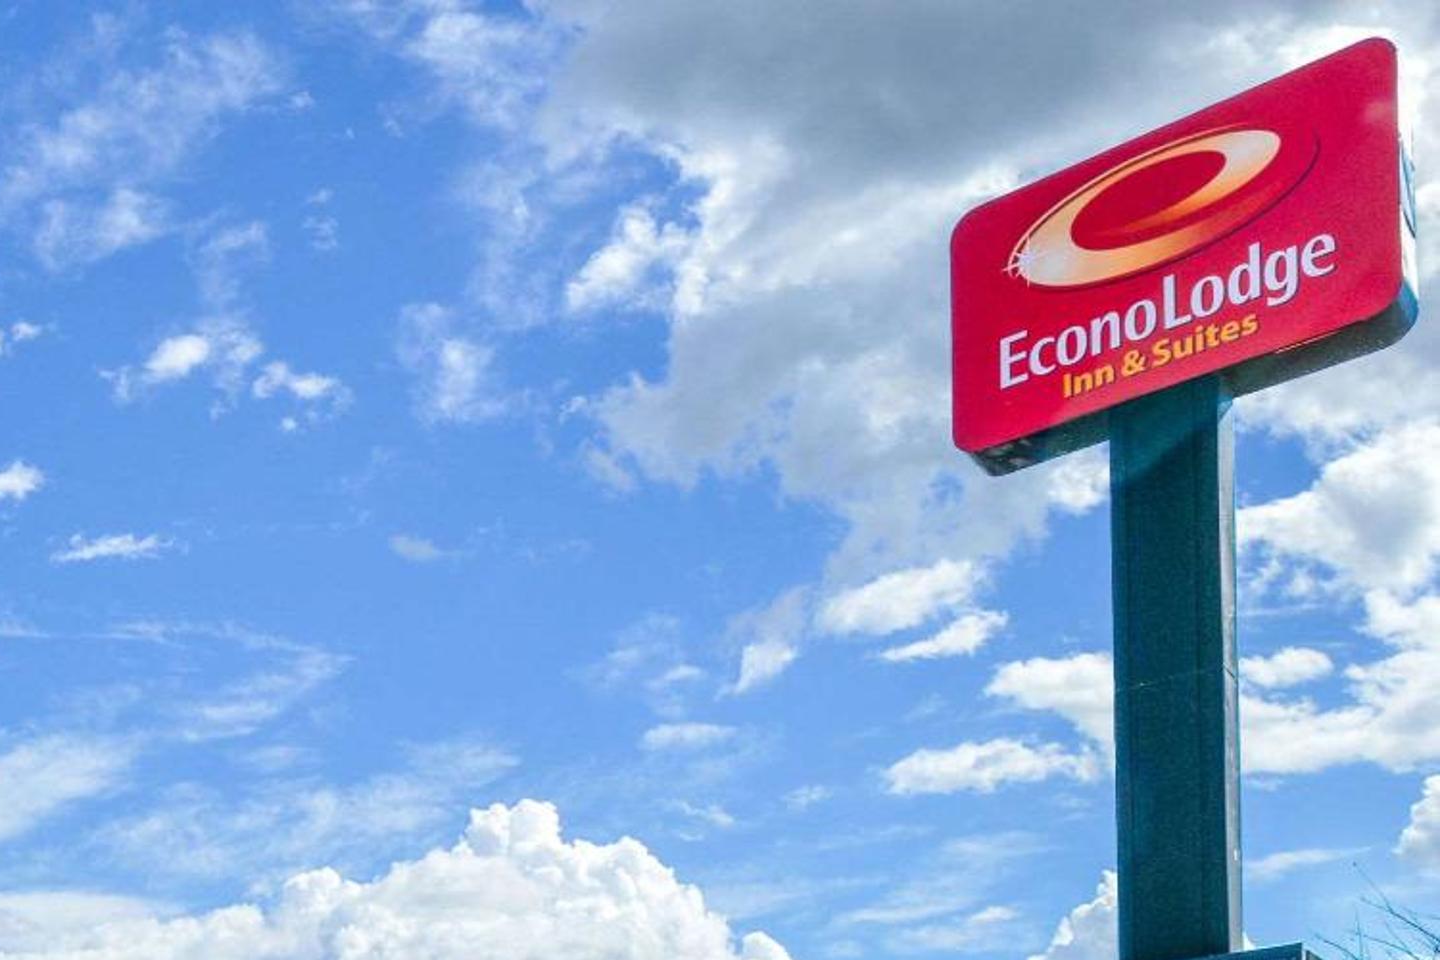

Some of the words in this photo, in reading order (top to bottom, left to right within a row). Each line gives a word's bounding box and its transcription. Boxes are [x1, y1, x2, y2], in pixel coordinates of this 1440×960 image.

[999, 233, 1337, 390] EconoLodge
[1063, 364, 1115, 398] Inn
[1121, 349, 1147, 376] &
[1151, 313, 1258, 366] Suites
